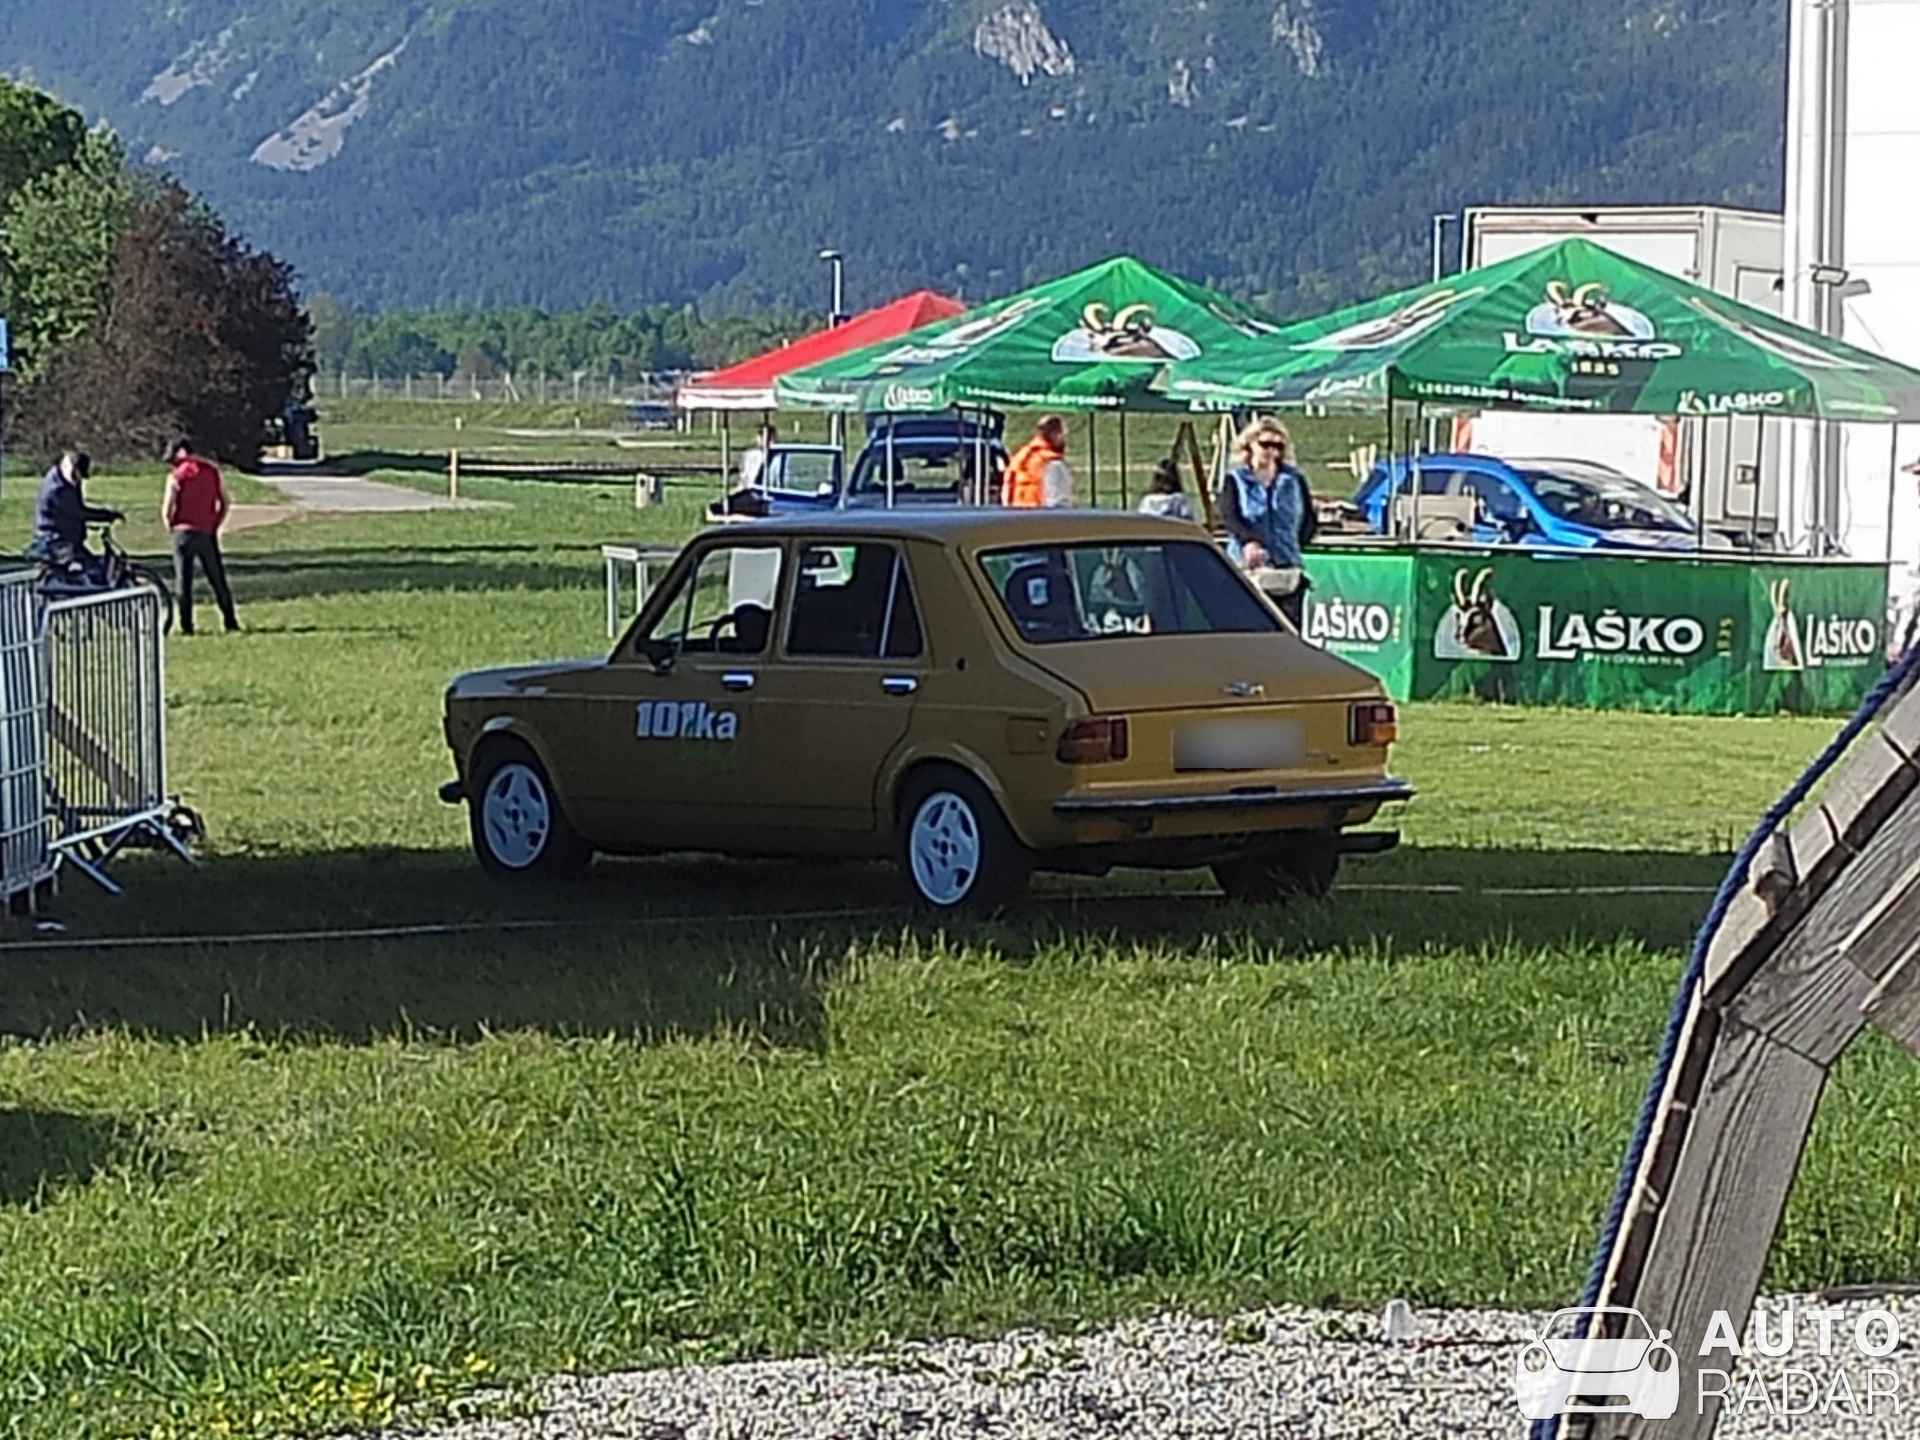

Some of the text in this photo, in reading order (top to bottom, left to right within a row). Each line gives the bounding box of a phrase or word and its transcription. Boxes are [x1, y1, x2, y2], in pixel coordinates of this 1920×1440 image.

[1301, 589, 1390, 649] LAŠKO
[1536, 605, 1703, 659] LAŠKO
[1806, 613, 1876, 667] LAŠKO
